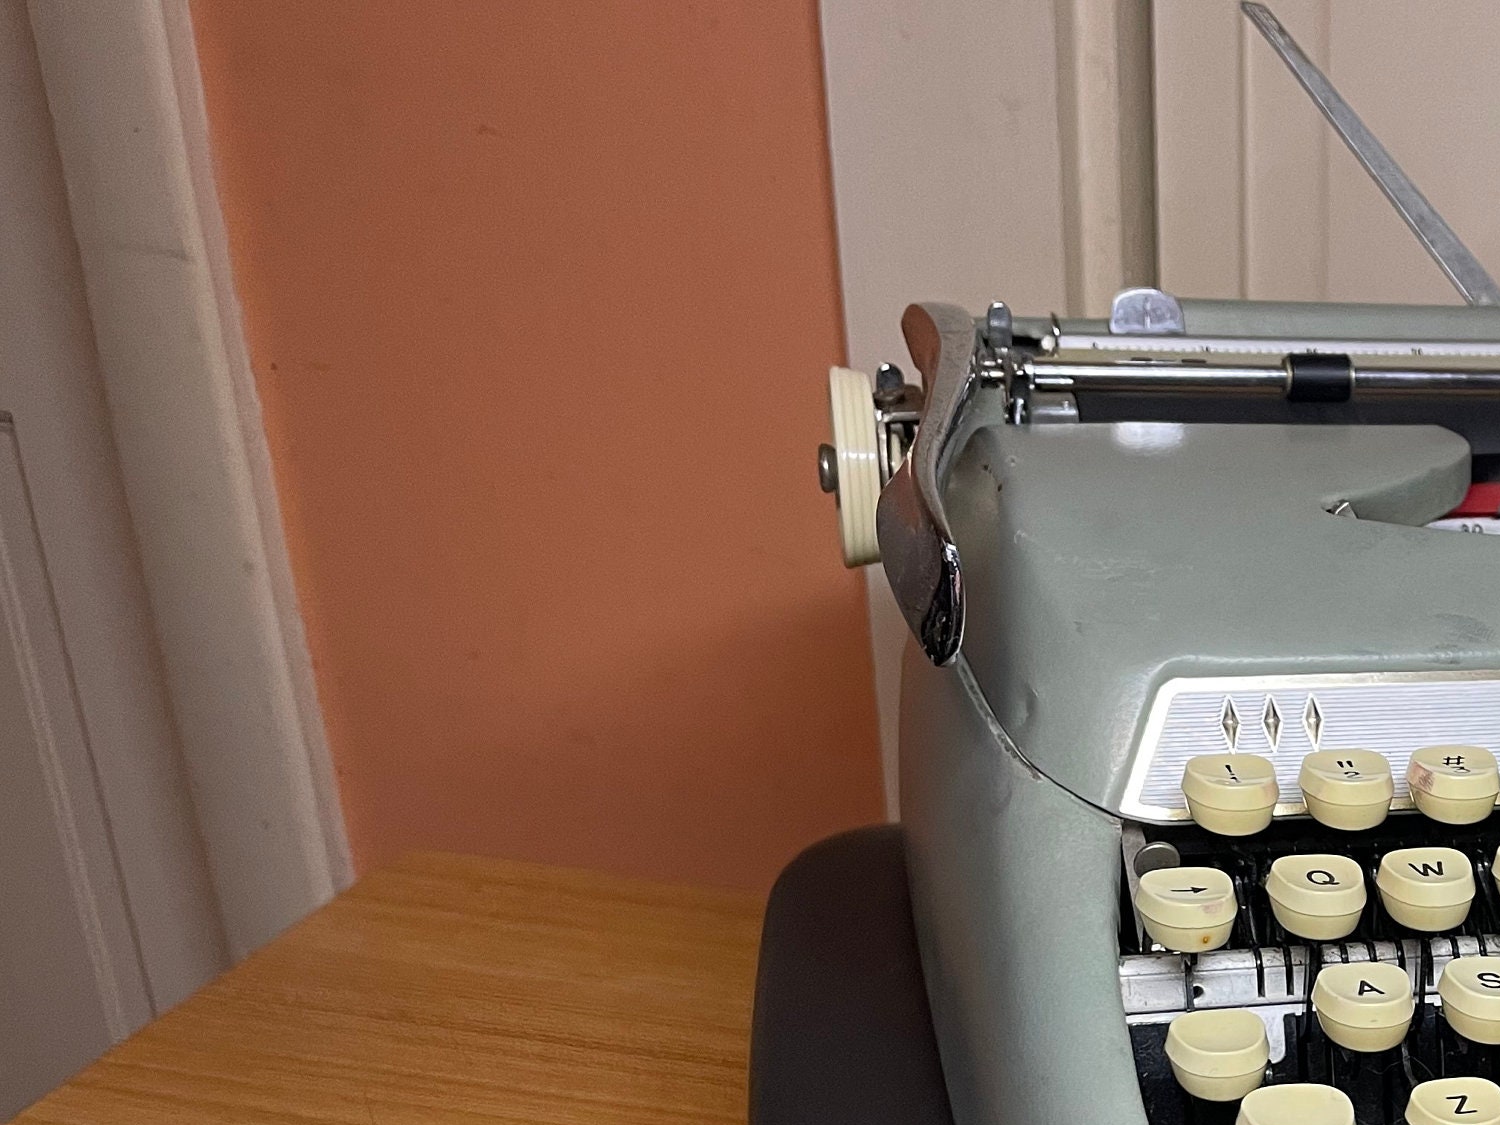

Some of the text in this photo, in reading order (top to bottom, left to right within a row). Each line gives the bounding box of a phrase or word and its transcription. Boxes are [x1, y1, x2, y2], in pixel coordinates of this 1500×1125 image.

[1441, 755, 1465, 766] #
[1344, 771, 1361, 779] 2
[1407, 860, 1444, 877] W
[1306, 869, 1341, 886] Q
[1357, 979, 1386, 997] A
[1445, 1094, 1478, 1115] Z
